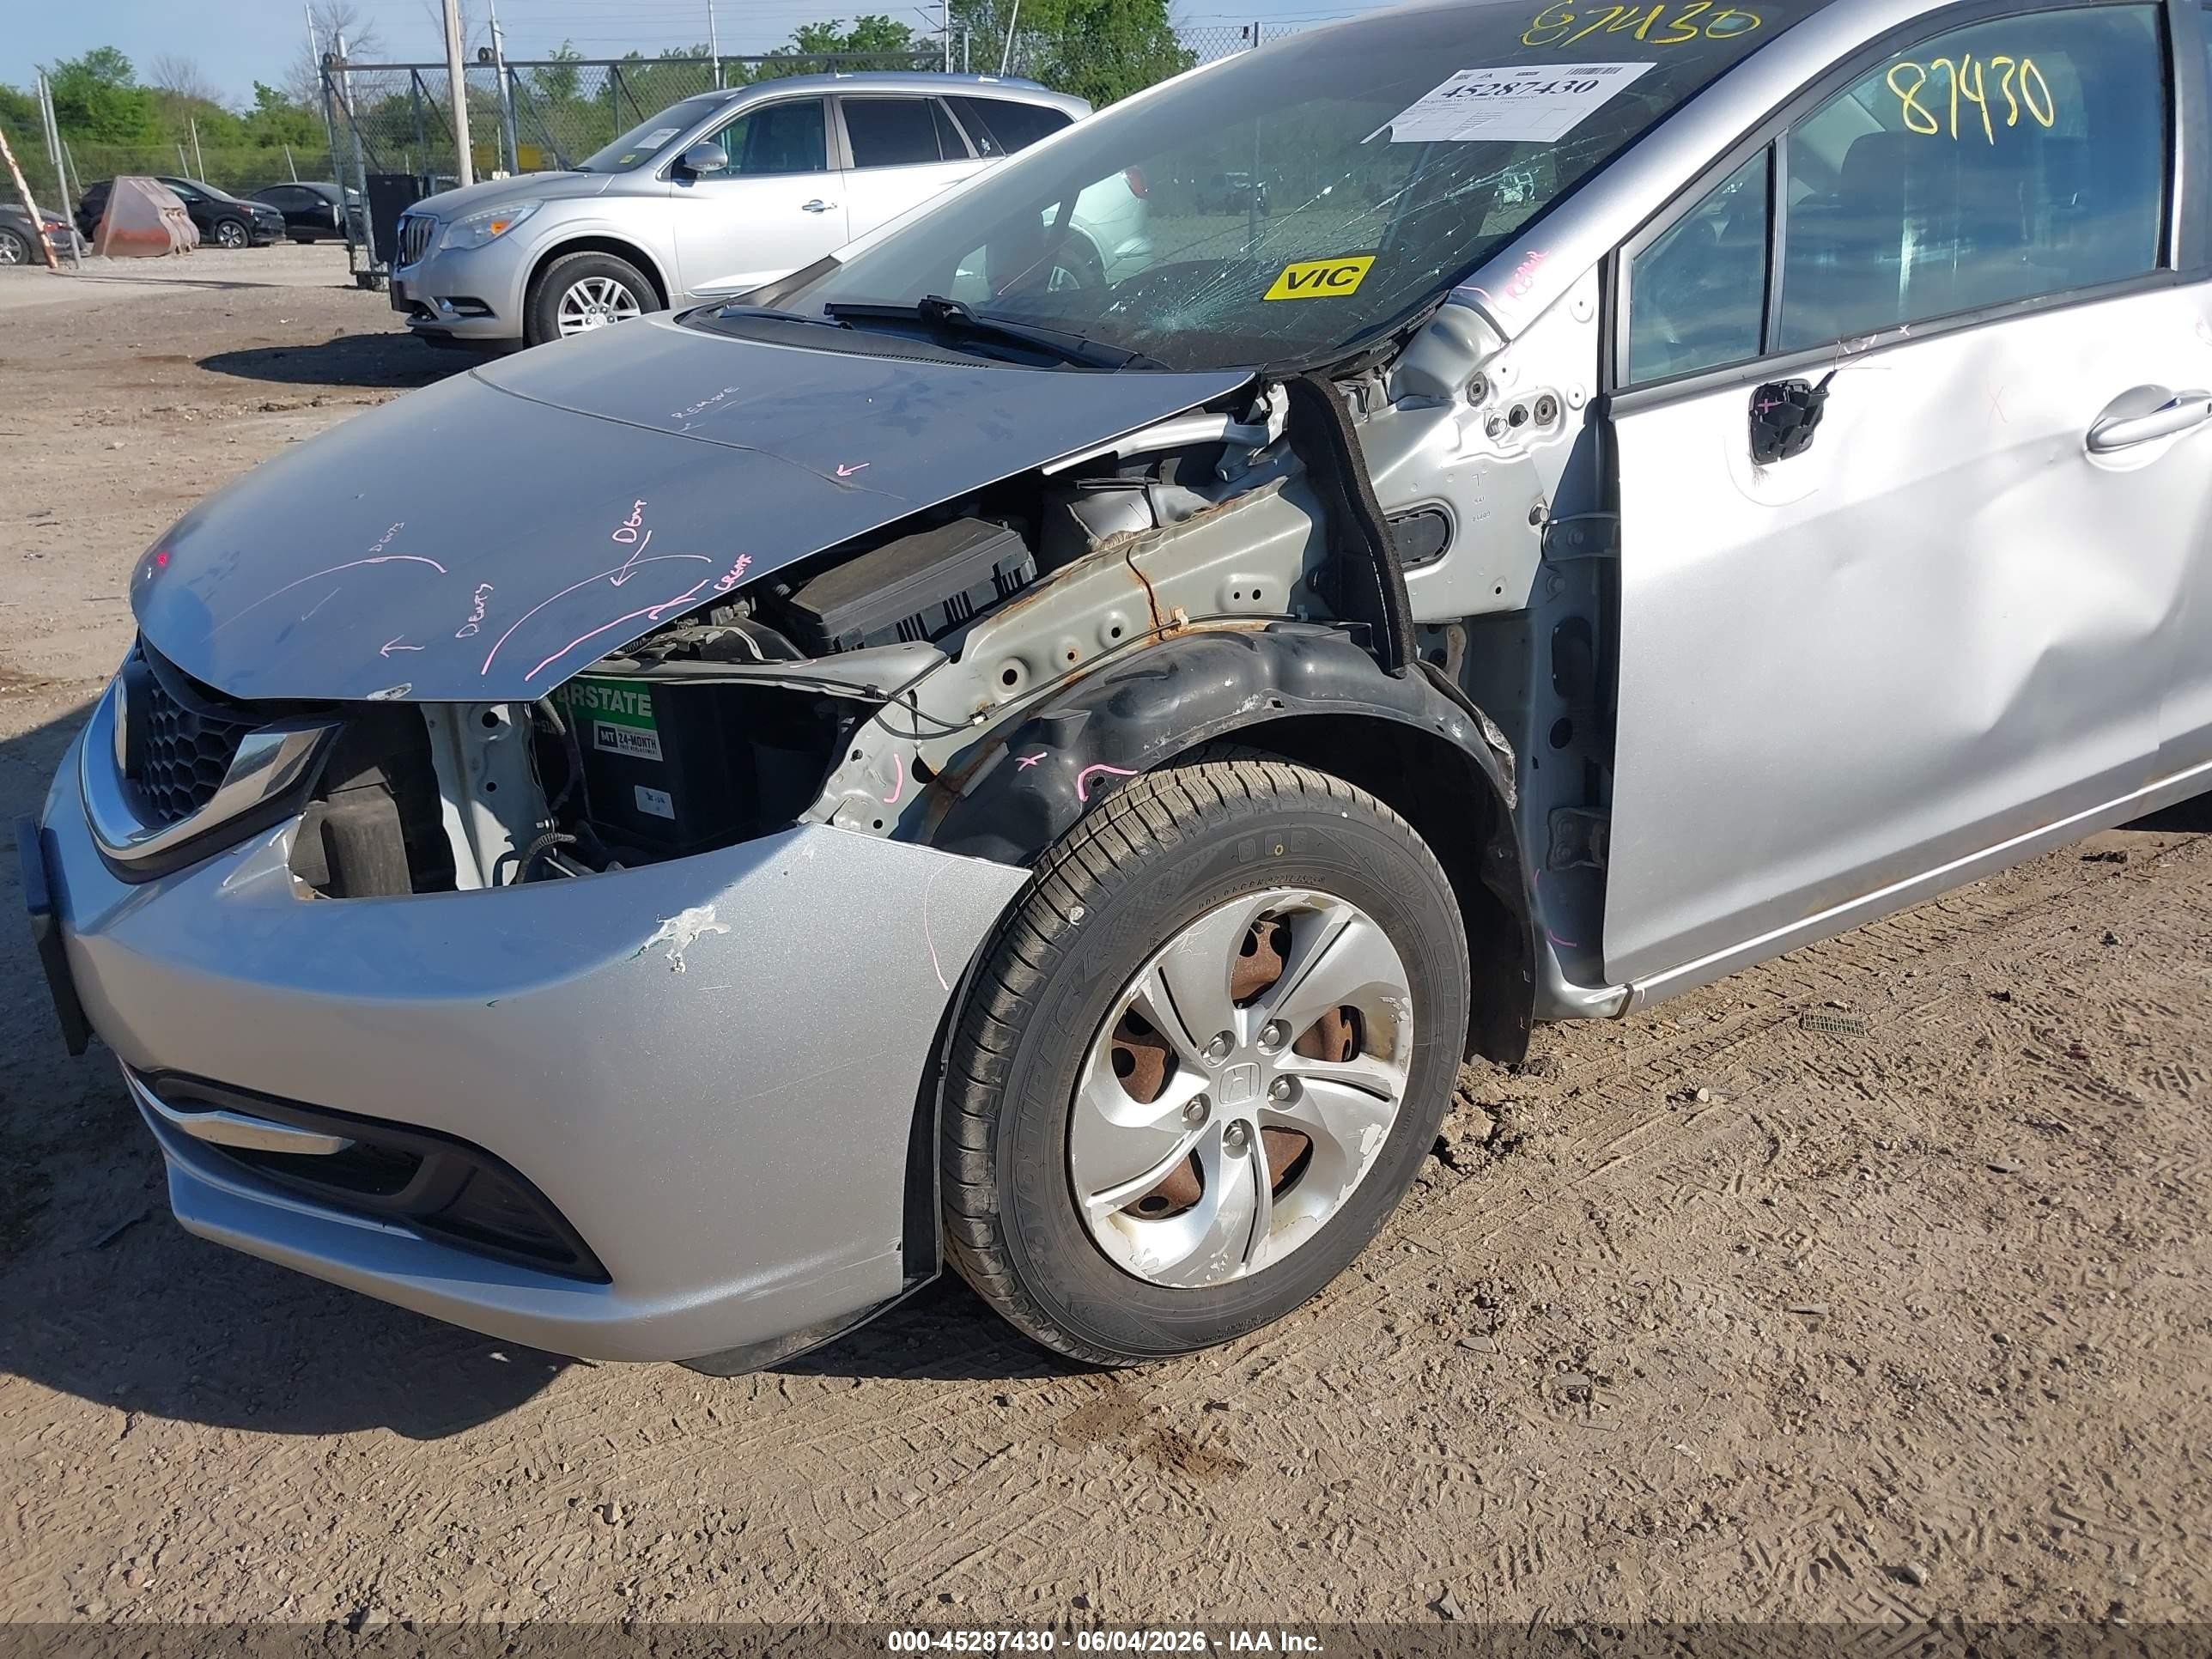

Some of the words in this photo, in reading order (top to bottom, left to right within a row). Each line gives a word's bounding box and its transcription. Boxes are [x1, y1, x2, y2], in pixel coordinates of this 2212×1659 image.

[1441, 79, 1600, 99] 45287430
[1887, 53, 2054, 146] 87430
[1287, 266, 1360, 290] VIC
[599, 730, 616, 744] MT
[619, 734, 657, 750] 24-MONTH
